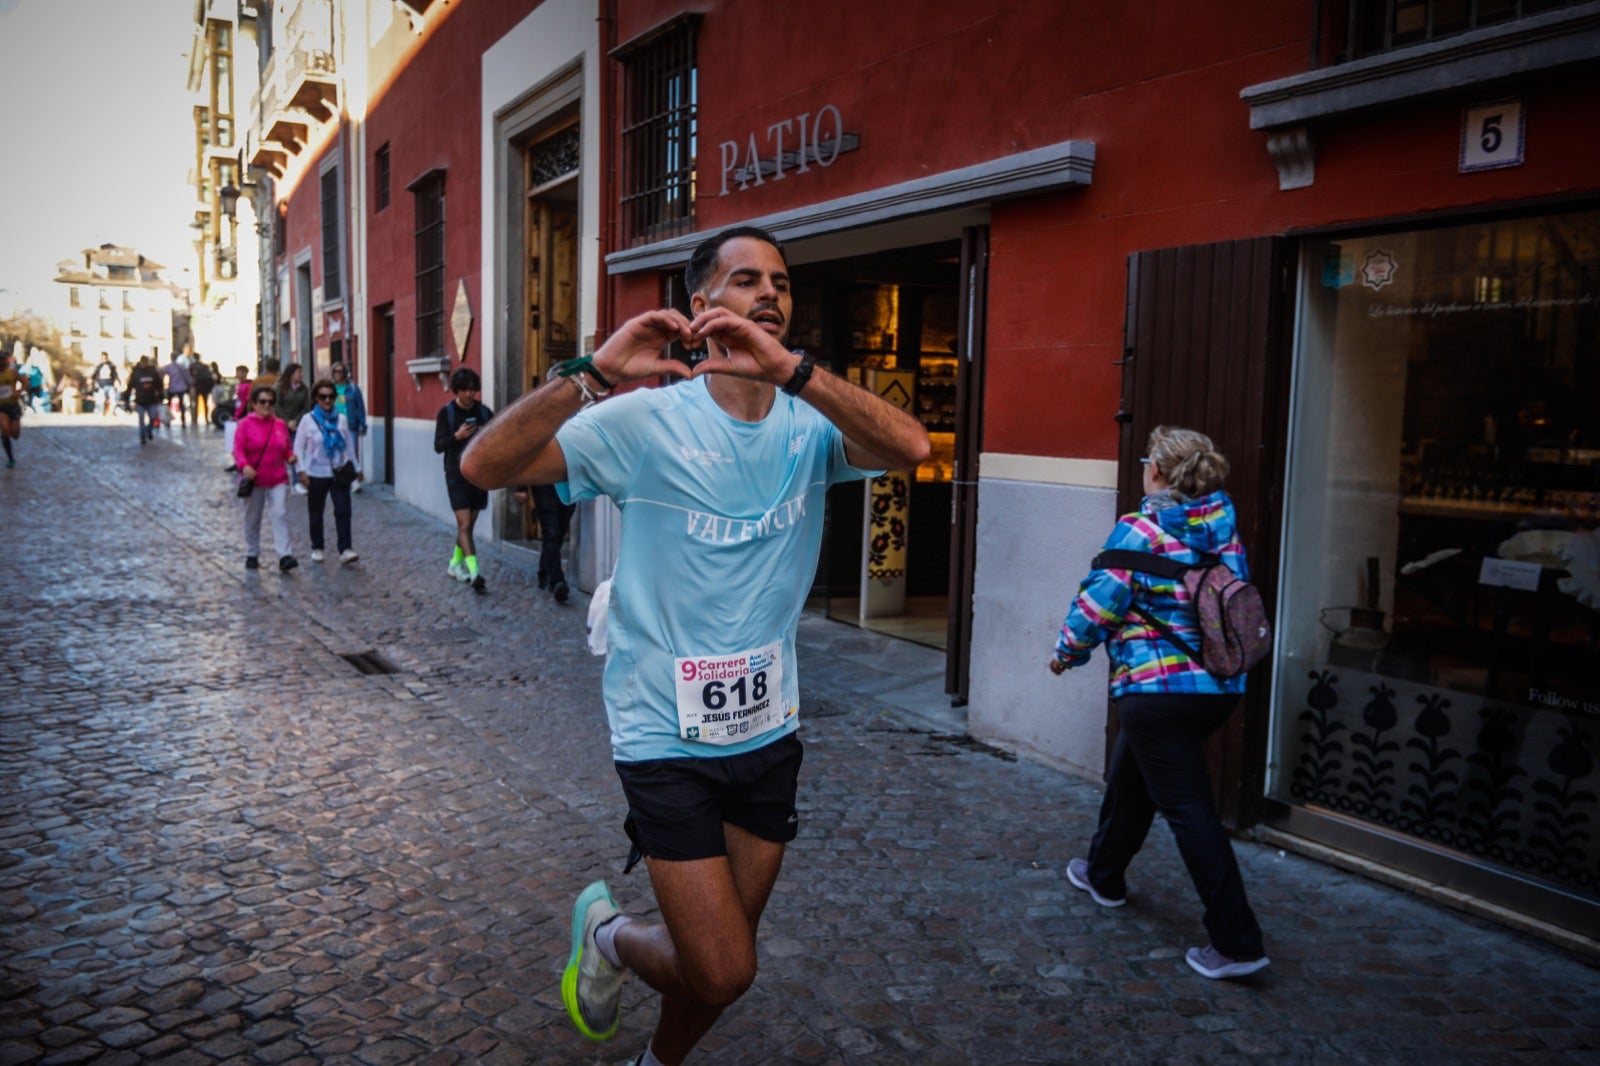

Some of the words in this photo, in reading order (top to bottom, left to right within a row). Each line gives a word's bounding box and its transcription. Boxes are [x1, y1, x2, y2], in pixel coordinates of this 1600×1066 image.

[1481, 114, 1503, 153] 5
[719, 104, 842, 196] PATIO
[681, 660, 697, 682] 9
[697, 666, 750, 681] Solidaria
[698, 657, 746, 671] Carrera
[702, 670, 768, 710] 618
[1528, 687, 1579, 709] Follow
[702, 710, 731, 723] JESÚS
